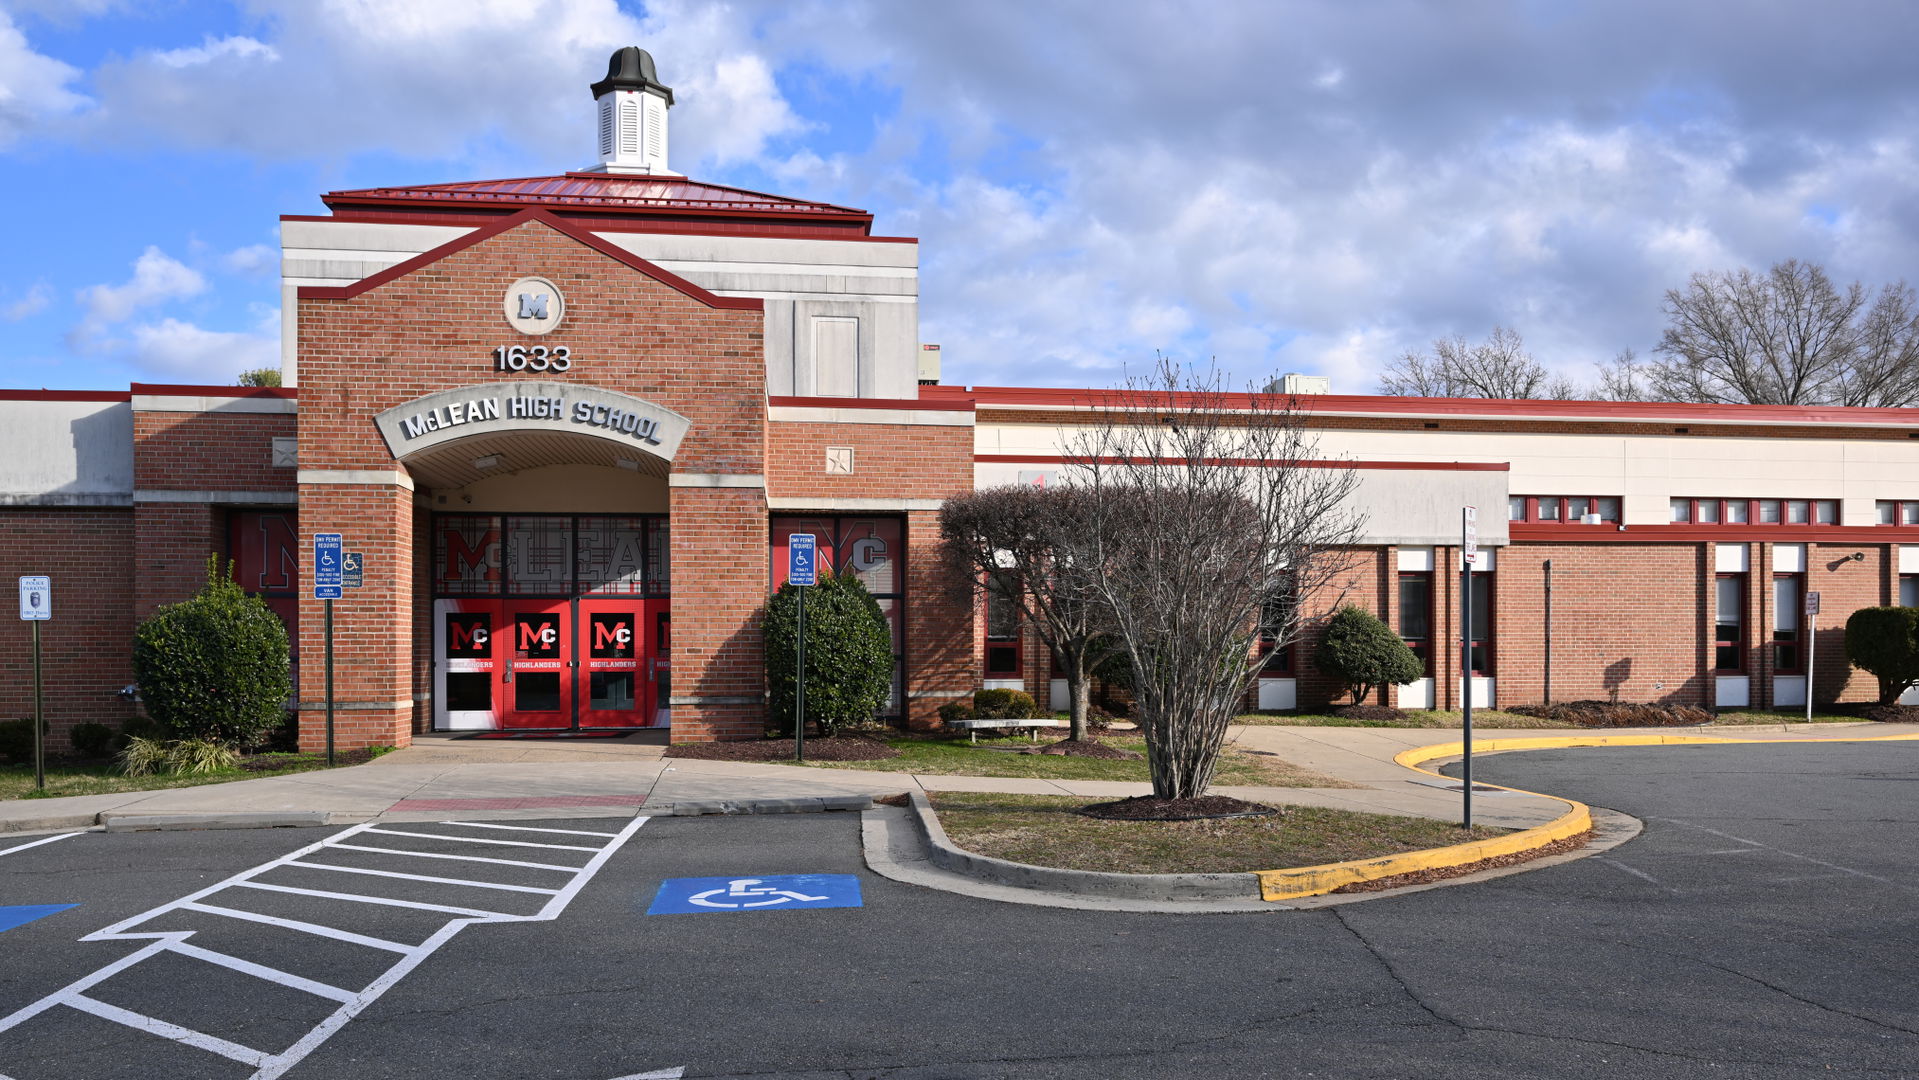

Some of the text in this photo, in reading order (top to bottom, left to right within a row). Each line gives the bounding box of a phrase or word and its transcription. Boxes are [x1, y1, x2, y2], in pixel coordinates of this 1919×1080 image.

[518, 293, 549, 319] M
[496, 345, 571, 371] 1633
[511, 396, 565, 417] HIGH
[576, 400, 663, 443] SCHOOL
